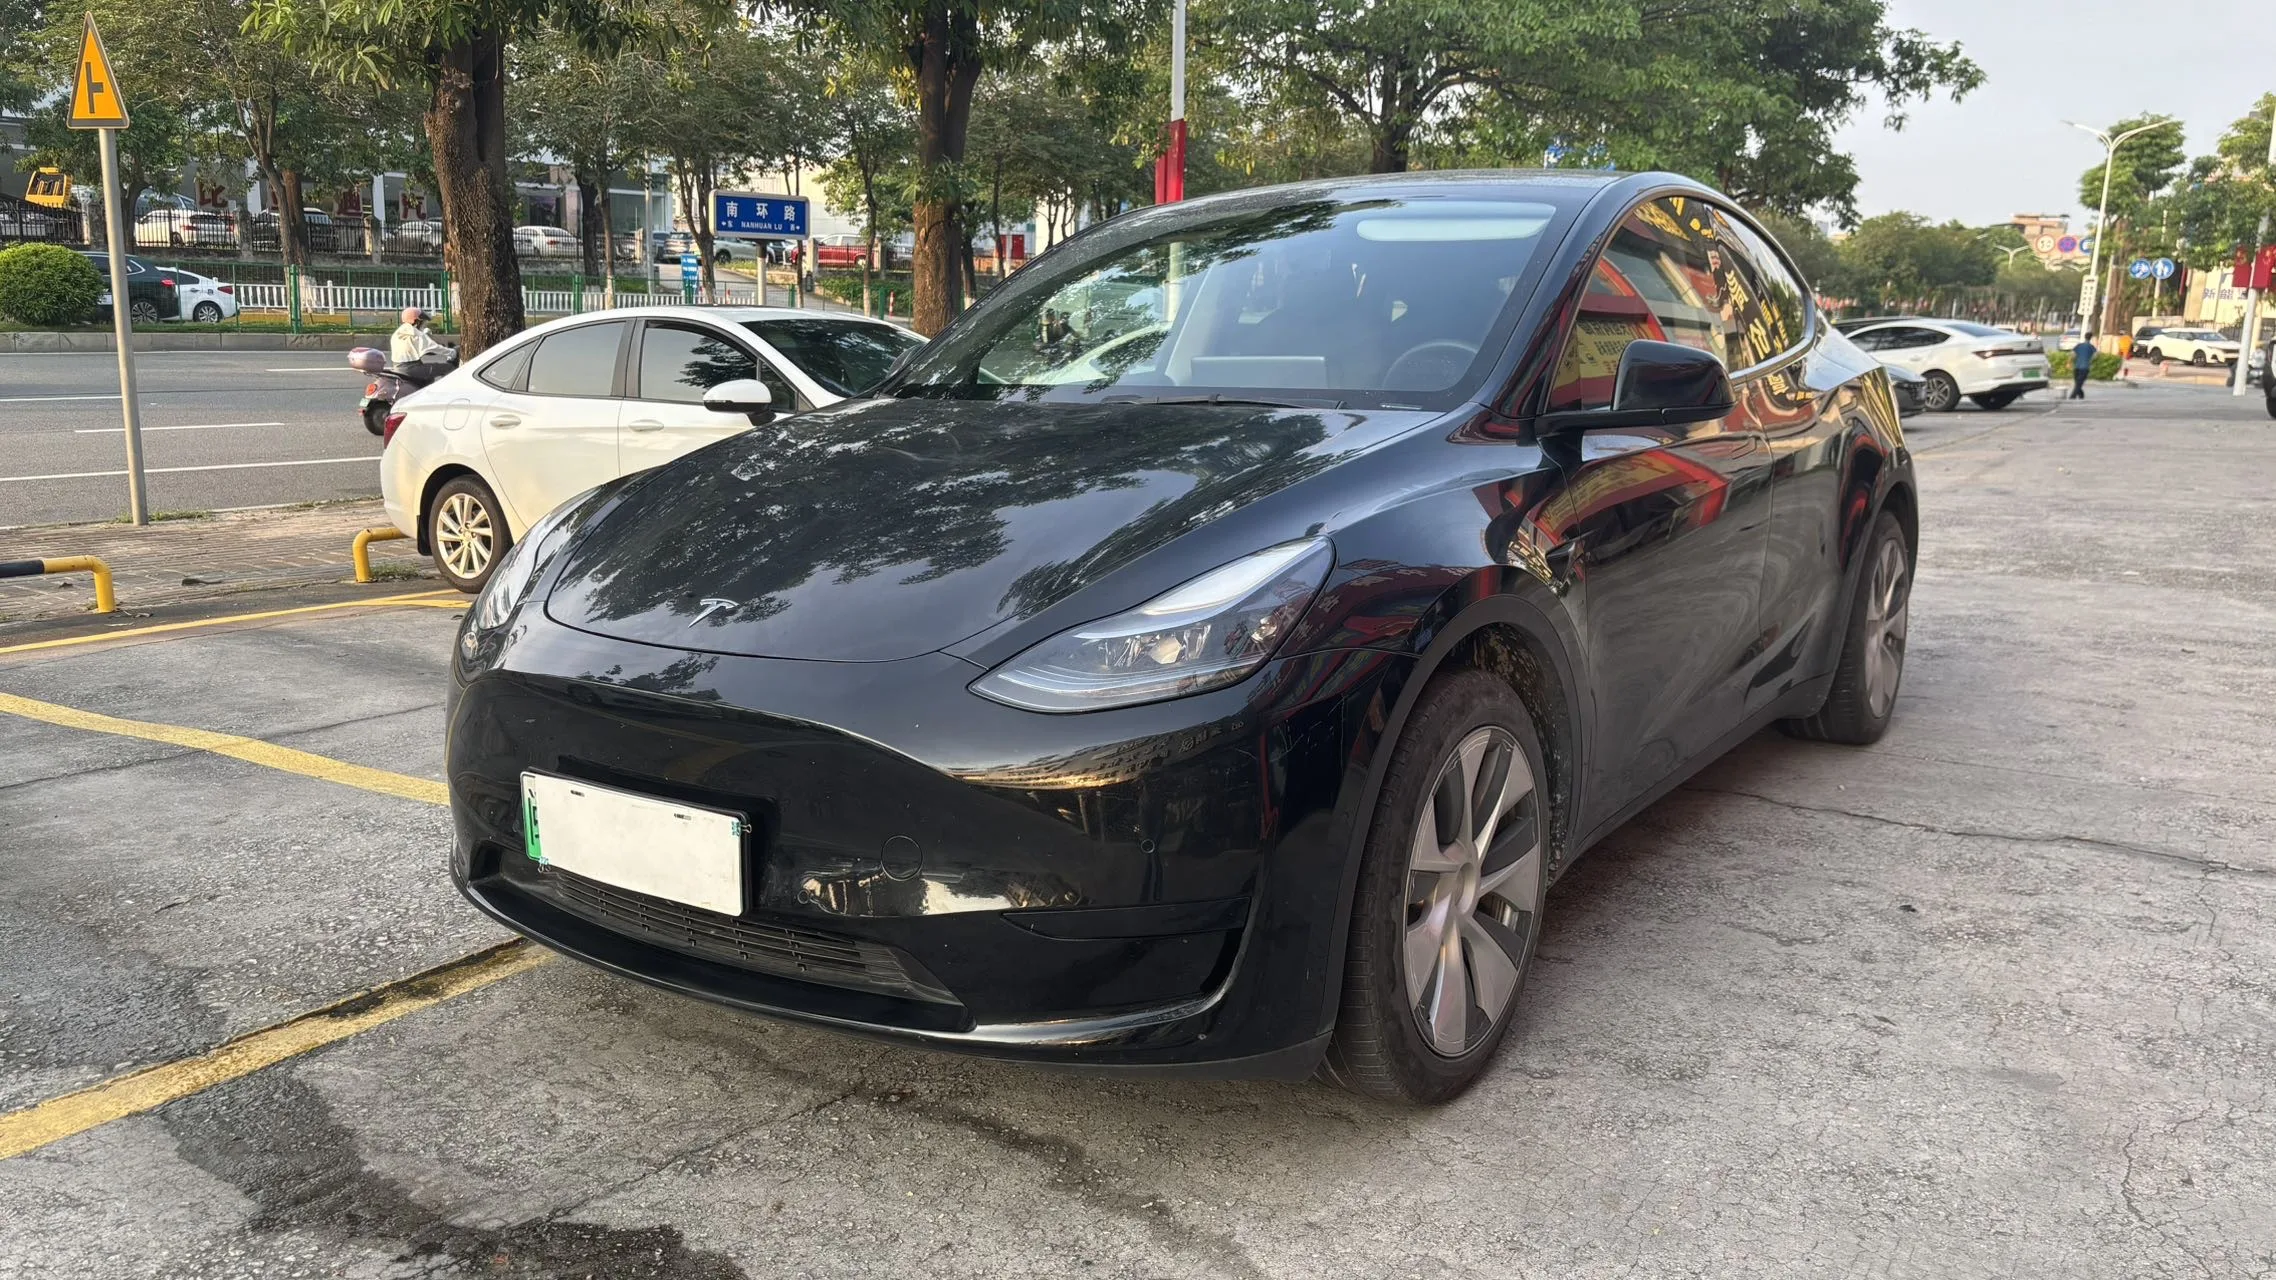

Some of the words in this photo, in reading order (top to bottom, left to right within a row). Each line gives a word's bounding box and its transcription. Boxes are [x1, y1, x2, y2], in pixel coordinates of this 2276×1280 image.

[726, 201, 796, 222] 南环路
[741, 221, 773, 230] NANHUAN
